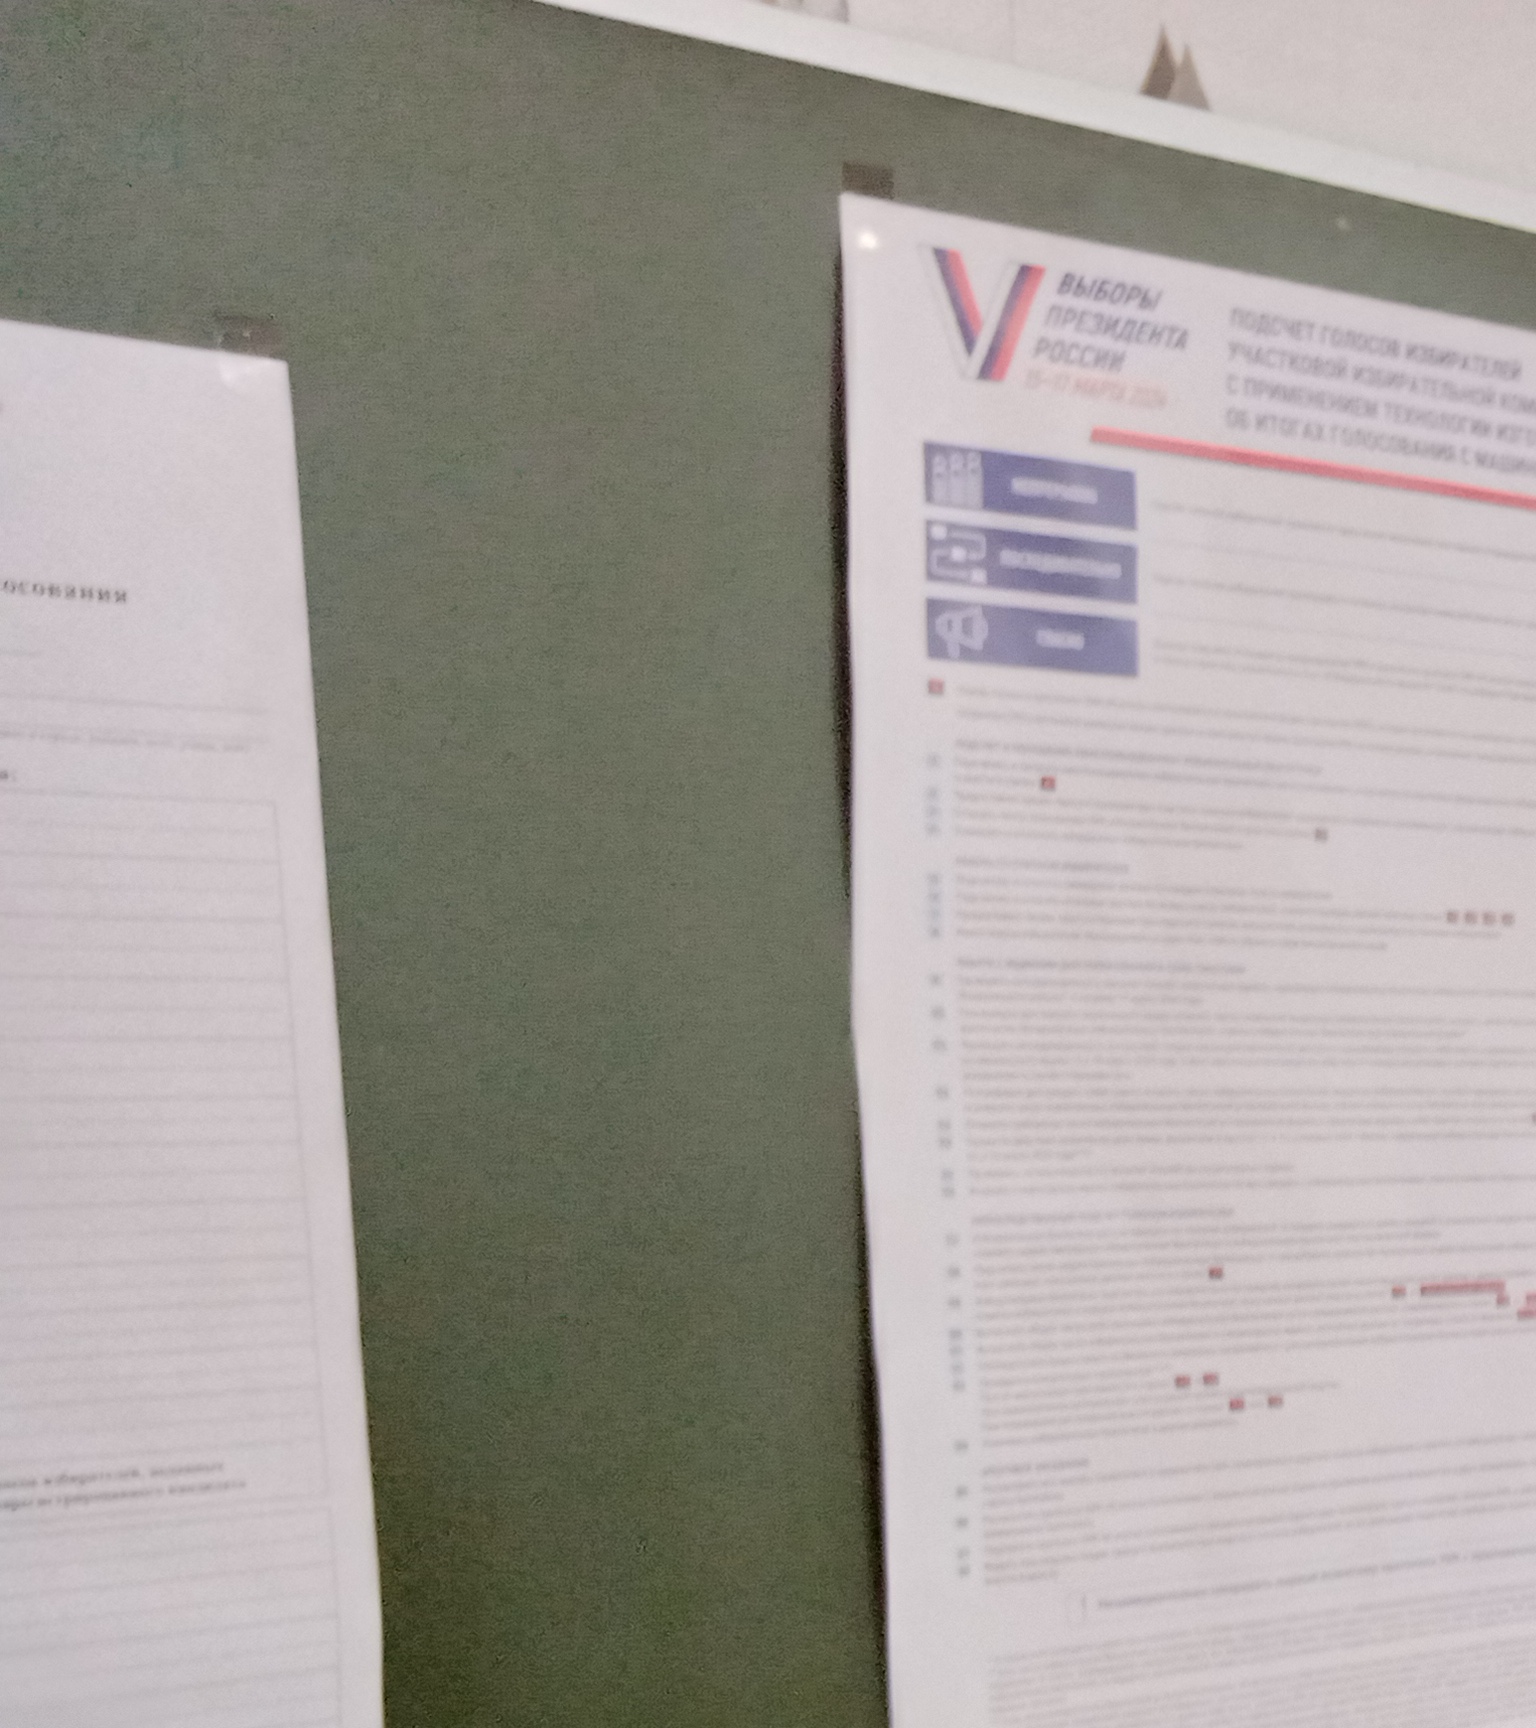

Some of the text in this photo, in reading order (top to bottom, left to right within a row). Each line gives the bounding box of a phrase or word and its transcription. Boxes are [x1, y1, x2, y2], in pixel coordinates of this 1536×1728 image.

[1056, 272, 1163, 311] ВЫБОРЫ
[1044, 304, 1189, 351] ПРЕЗИДЕНТА
[1230, 307, 1522, 380] ПОДСЧЕТ ГОЛОСОВ ИЗБИРАТЕЛЕЙ
[1033, 336, 1127, 373] РОССИИ
[1228, 340, 1347, 379] УЧАСТКОВОЙ
[1353, 364, 1496, 406] ИЗБИРАТЕЛЬНОЙ
[1226, 372, 1238, 395] С
[1244, 376, 1378, 418] ПРИМЕНЕНИЕМ
[1384, 400, 1491, 437] ТЕХНОЛОГИИ
[1255, 413, 1324, 441] ИТОГАХ
[1329, 423, 1456, 461] ГОЛОСОВАНИЯ
